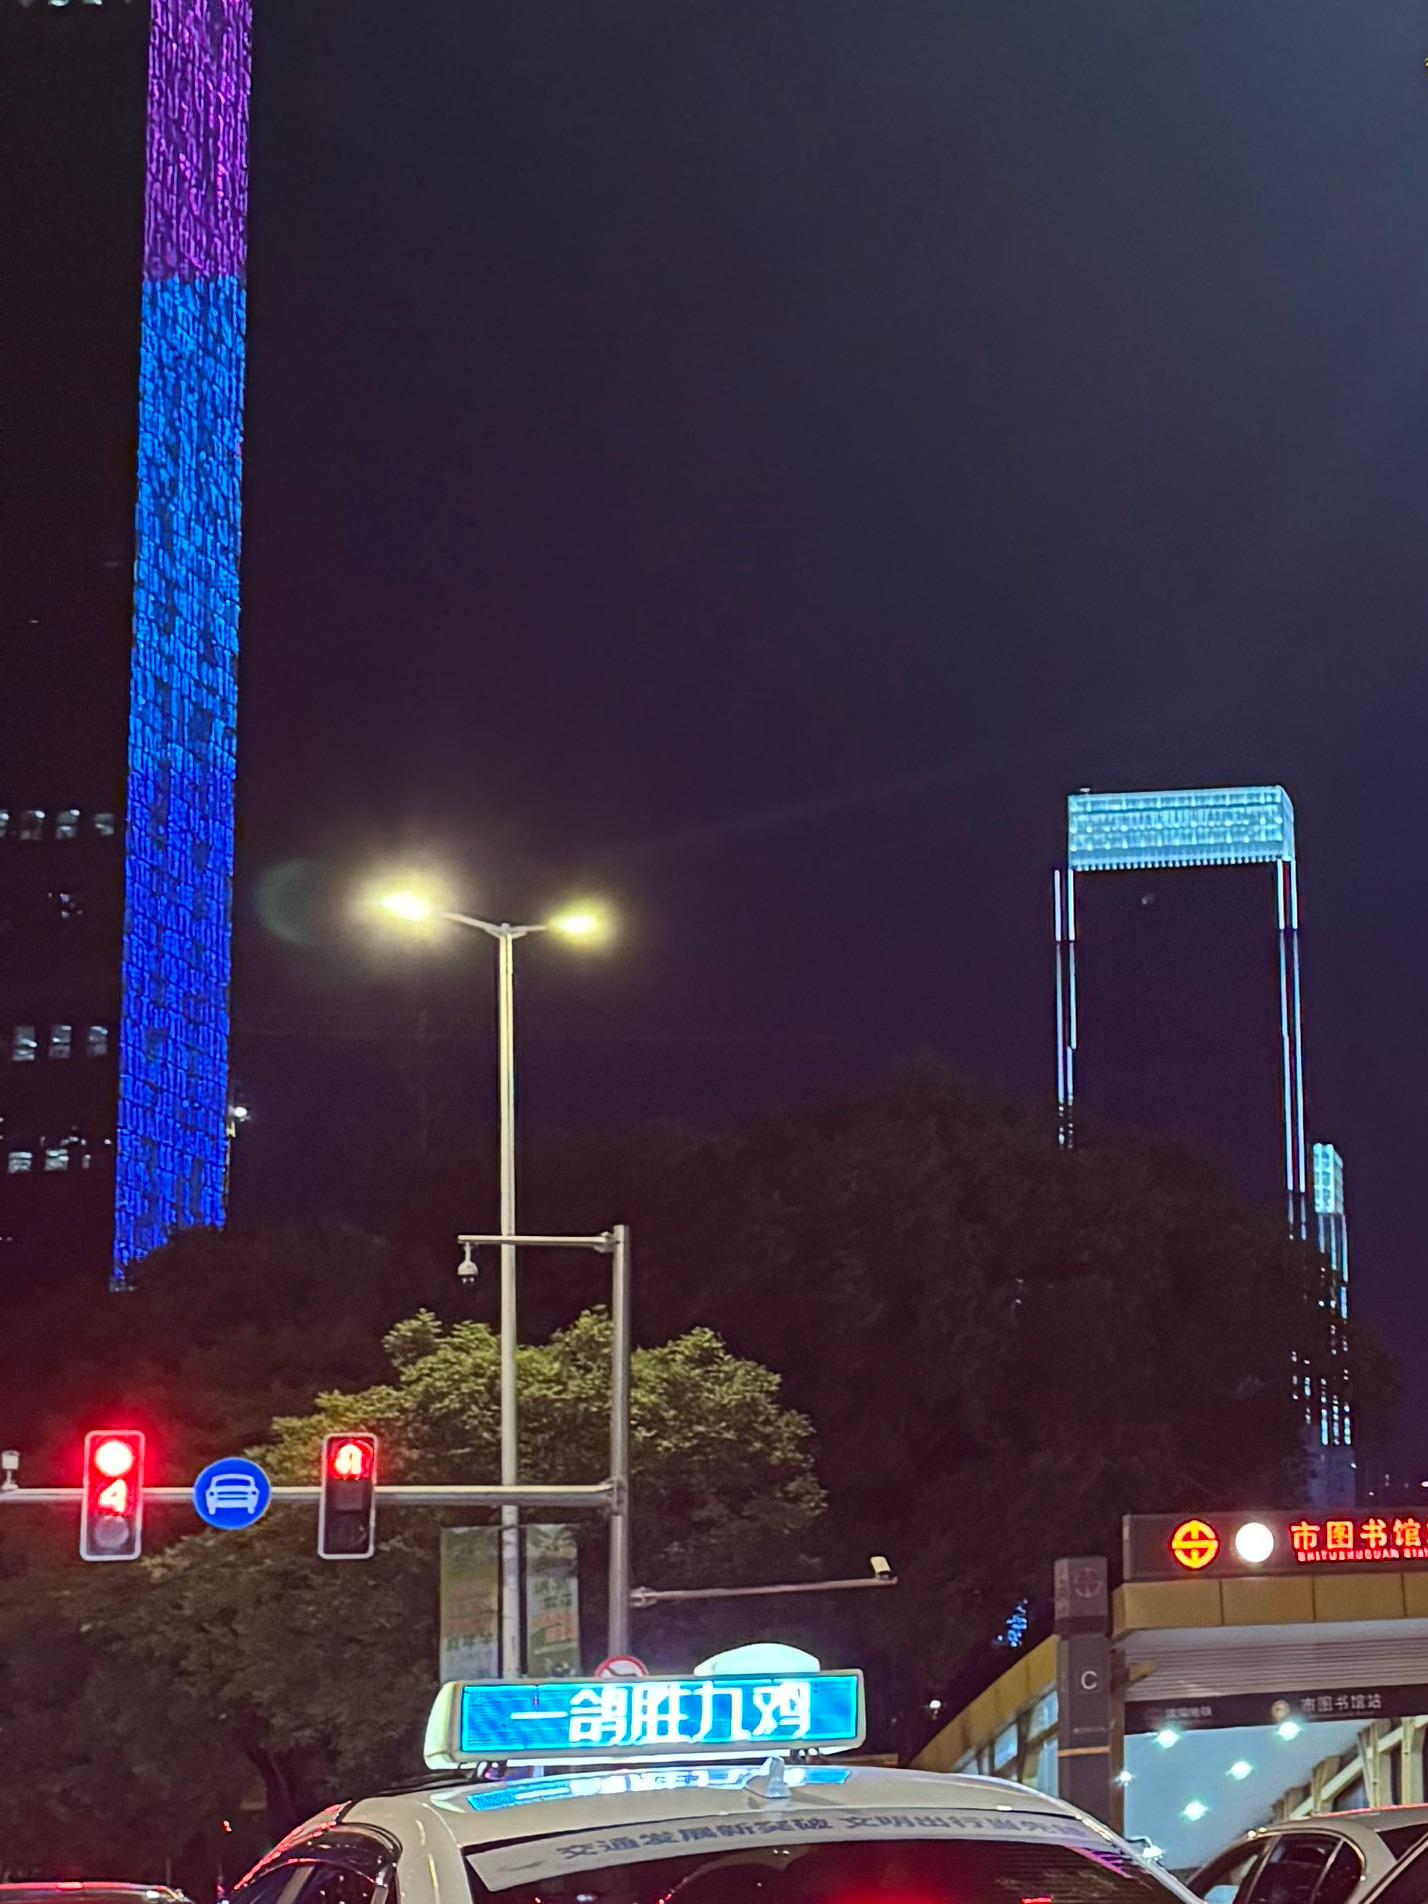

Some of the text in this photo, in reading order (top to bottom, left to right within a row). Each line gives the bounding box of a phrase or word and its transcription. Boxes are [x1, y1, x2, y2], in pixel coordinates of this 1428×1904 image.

[99, 1479, 126, 1514] 4
[1081, 1671, 1098, 1690] C
[510, 1680, 812, 1745] 一鸽胜九鸡
[1299, 1693, 1382, 1713] 市图书馆站
